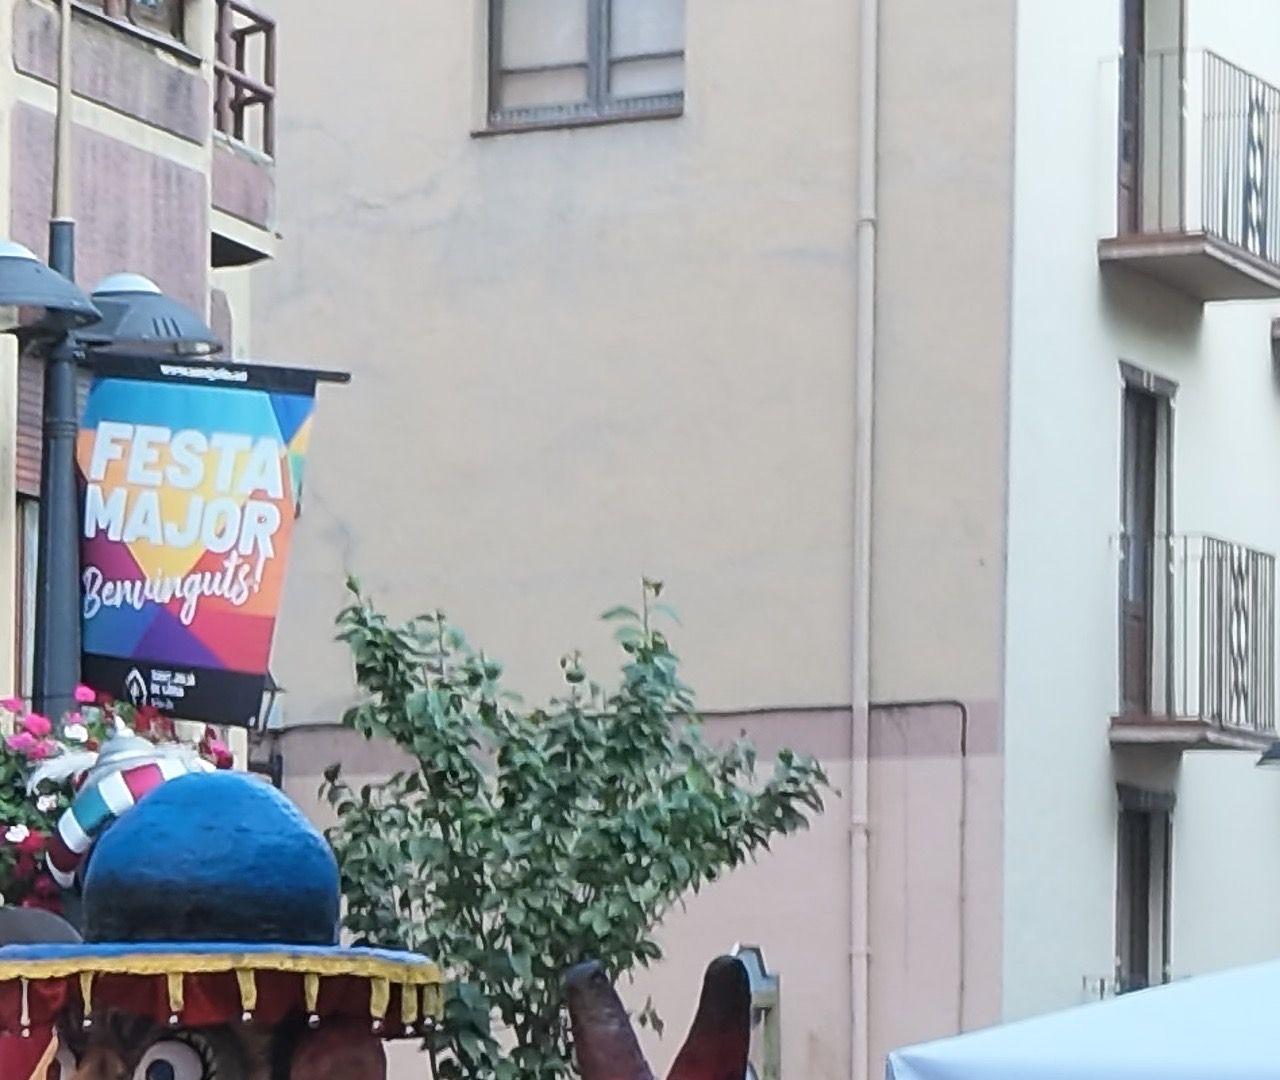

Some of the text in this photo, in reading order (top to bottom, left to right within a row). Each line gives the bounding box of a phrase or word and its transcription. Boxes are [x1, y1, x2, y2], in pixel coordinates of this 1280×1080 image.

[90, 420, 284, 500] FESTA
[84, 483, 281, 559] MAJOR
[81, 549, 268, 627] Benvinguts!
